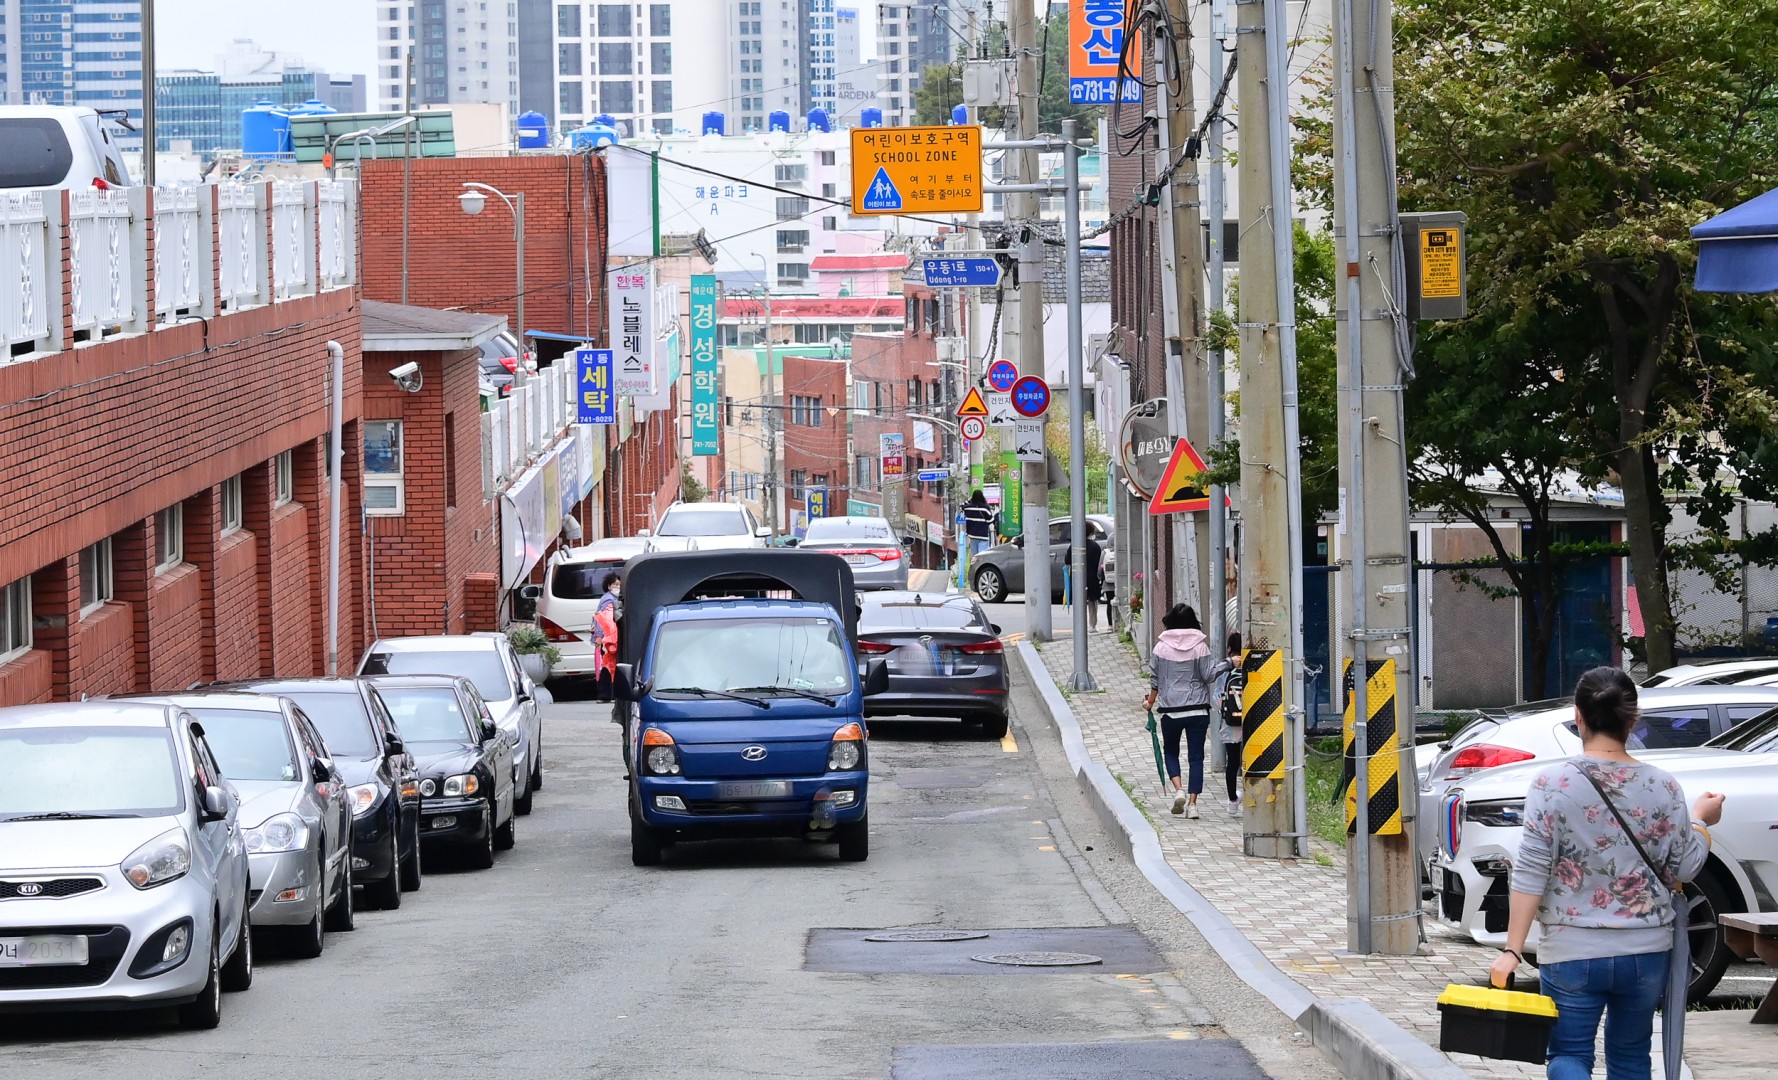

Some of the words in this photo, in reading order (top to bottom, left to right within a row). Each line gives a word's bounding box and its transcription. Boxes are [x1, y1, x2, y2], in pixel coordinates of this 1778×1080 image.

[863, 132, 969, 148] 어린이보호구역
[874, 151, 920, 163] SCHOOL
[926, 150, 957, 162] ZONE
[910, 190, 936, 200] 속도를
[938, 188, 972, 200] 줄이시오
[710, 203, 719, 215] A
[927, 261, 967, 275] 우동1로
[617, 275, 644, 289] 한복
[929, 276, 952, 284] Udong
[693, 284, 714, 296] 해운대
[623, 296, 642, 373] 노블레스
[582, 353, 608, 364] 신동
[693, 303, 717, 428] 경성학원
[582, 366, 610, 414] 세탁
[991, 397, 1011, 405] 견인지
[966, 423, 979, 434] 30
[694, 440, 716, 448] 741-7052
[811, 492, 823, 518] 에어
